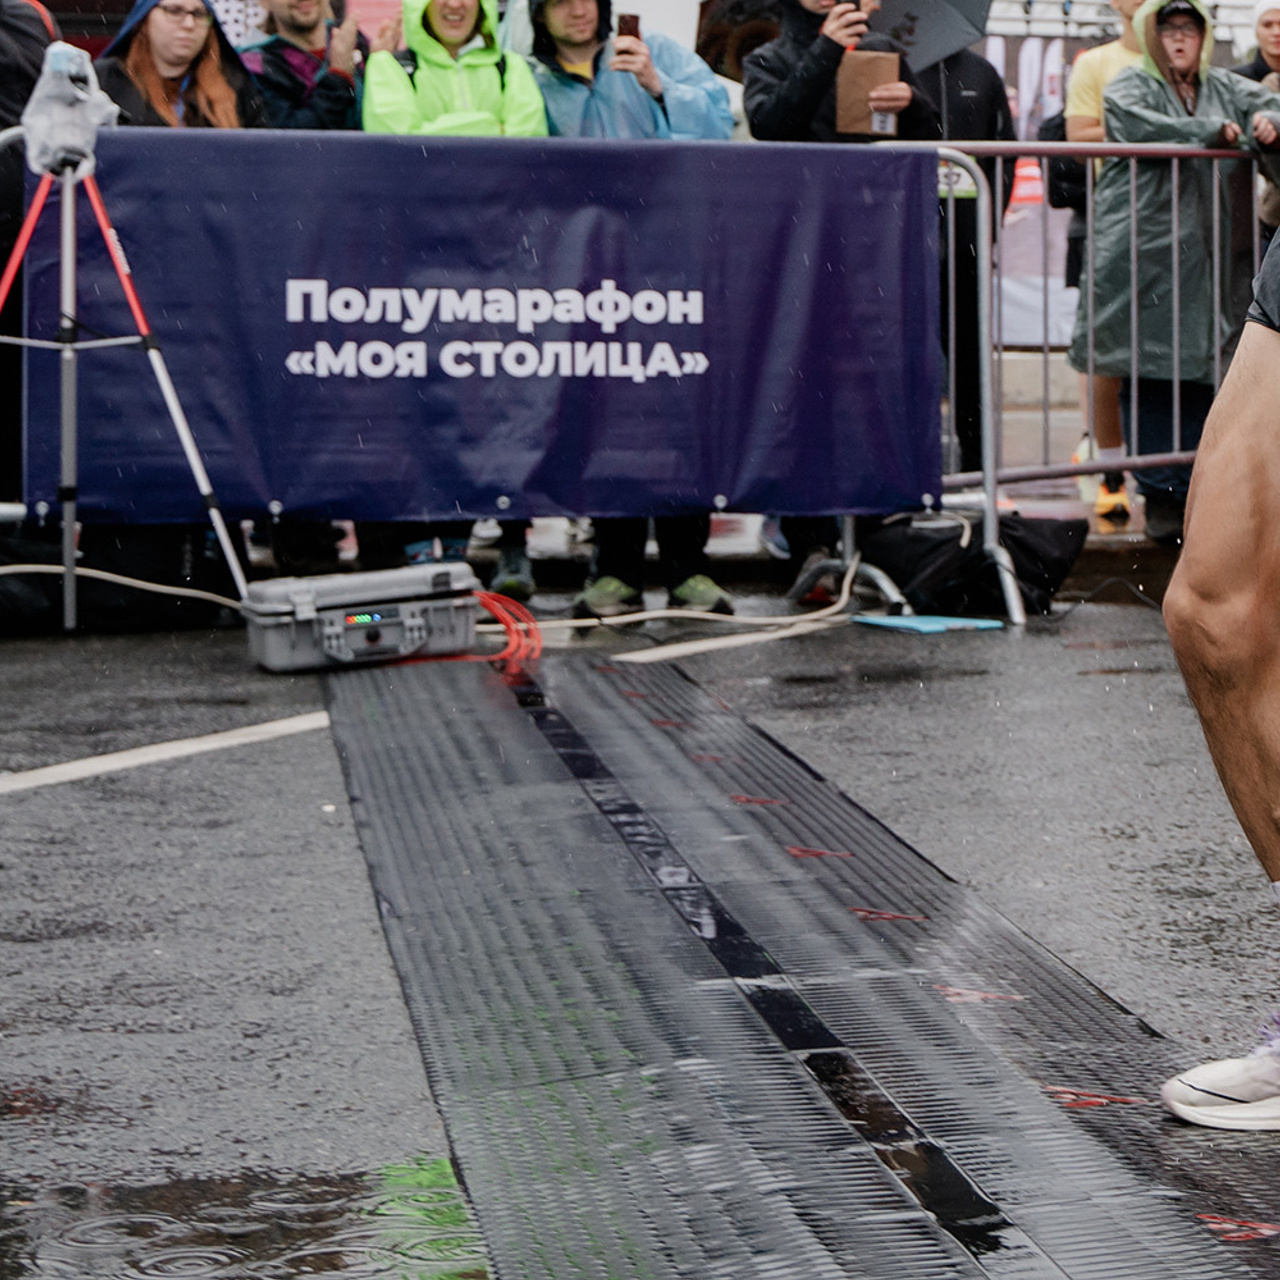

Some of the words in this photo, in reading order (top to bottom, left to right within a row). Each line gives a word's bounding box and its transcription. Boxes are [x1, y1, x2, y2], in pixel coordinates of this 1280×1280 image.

[285, 278, 704, 334] Полумарафон
[285, 340, 428, 378] «МОЯ
[438, 340, 711, 383] СТОЛИЦА»
